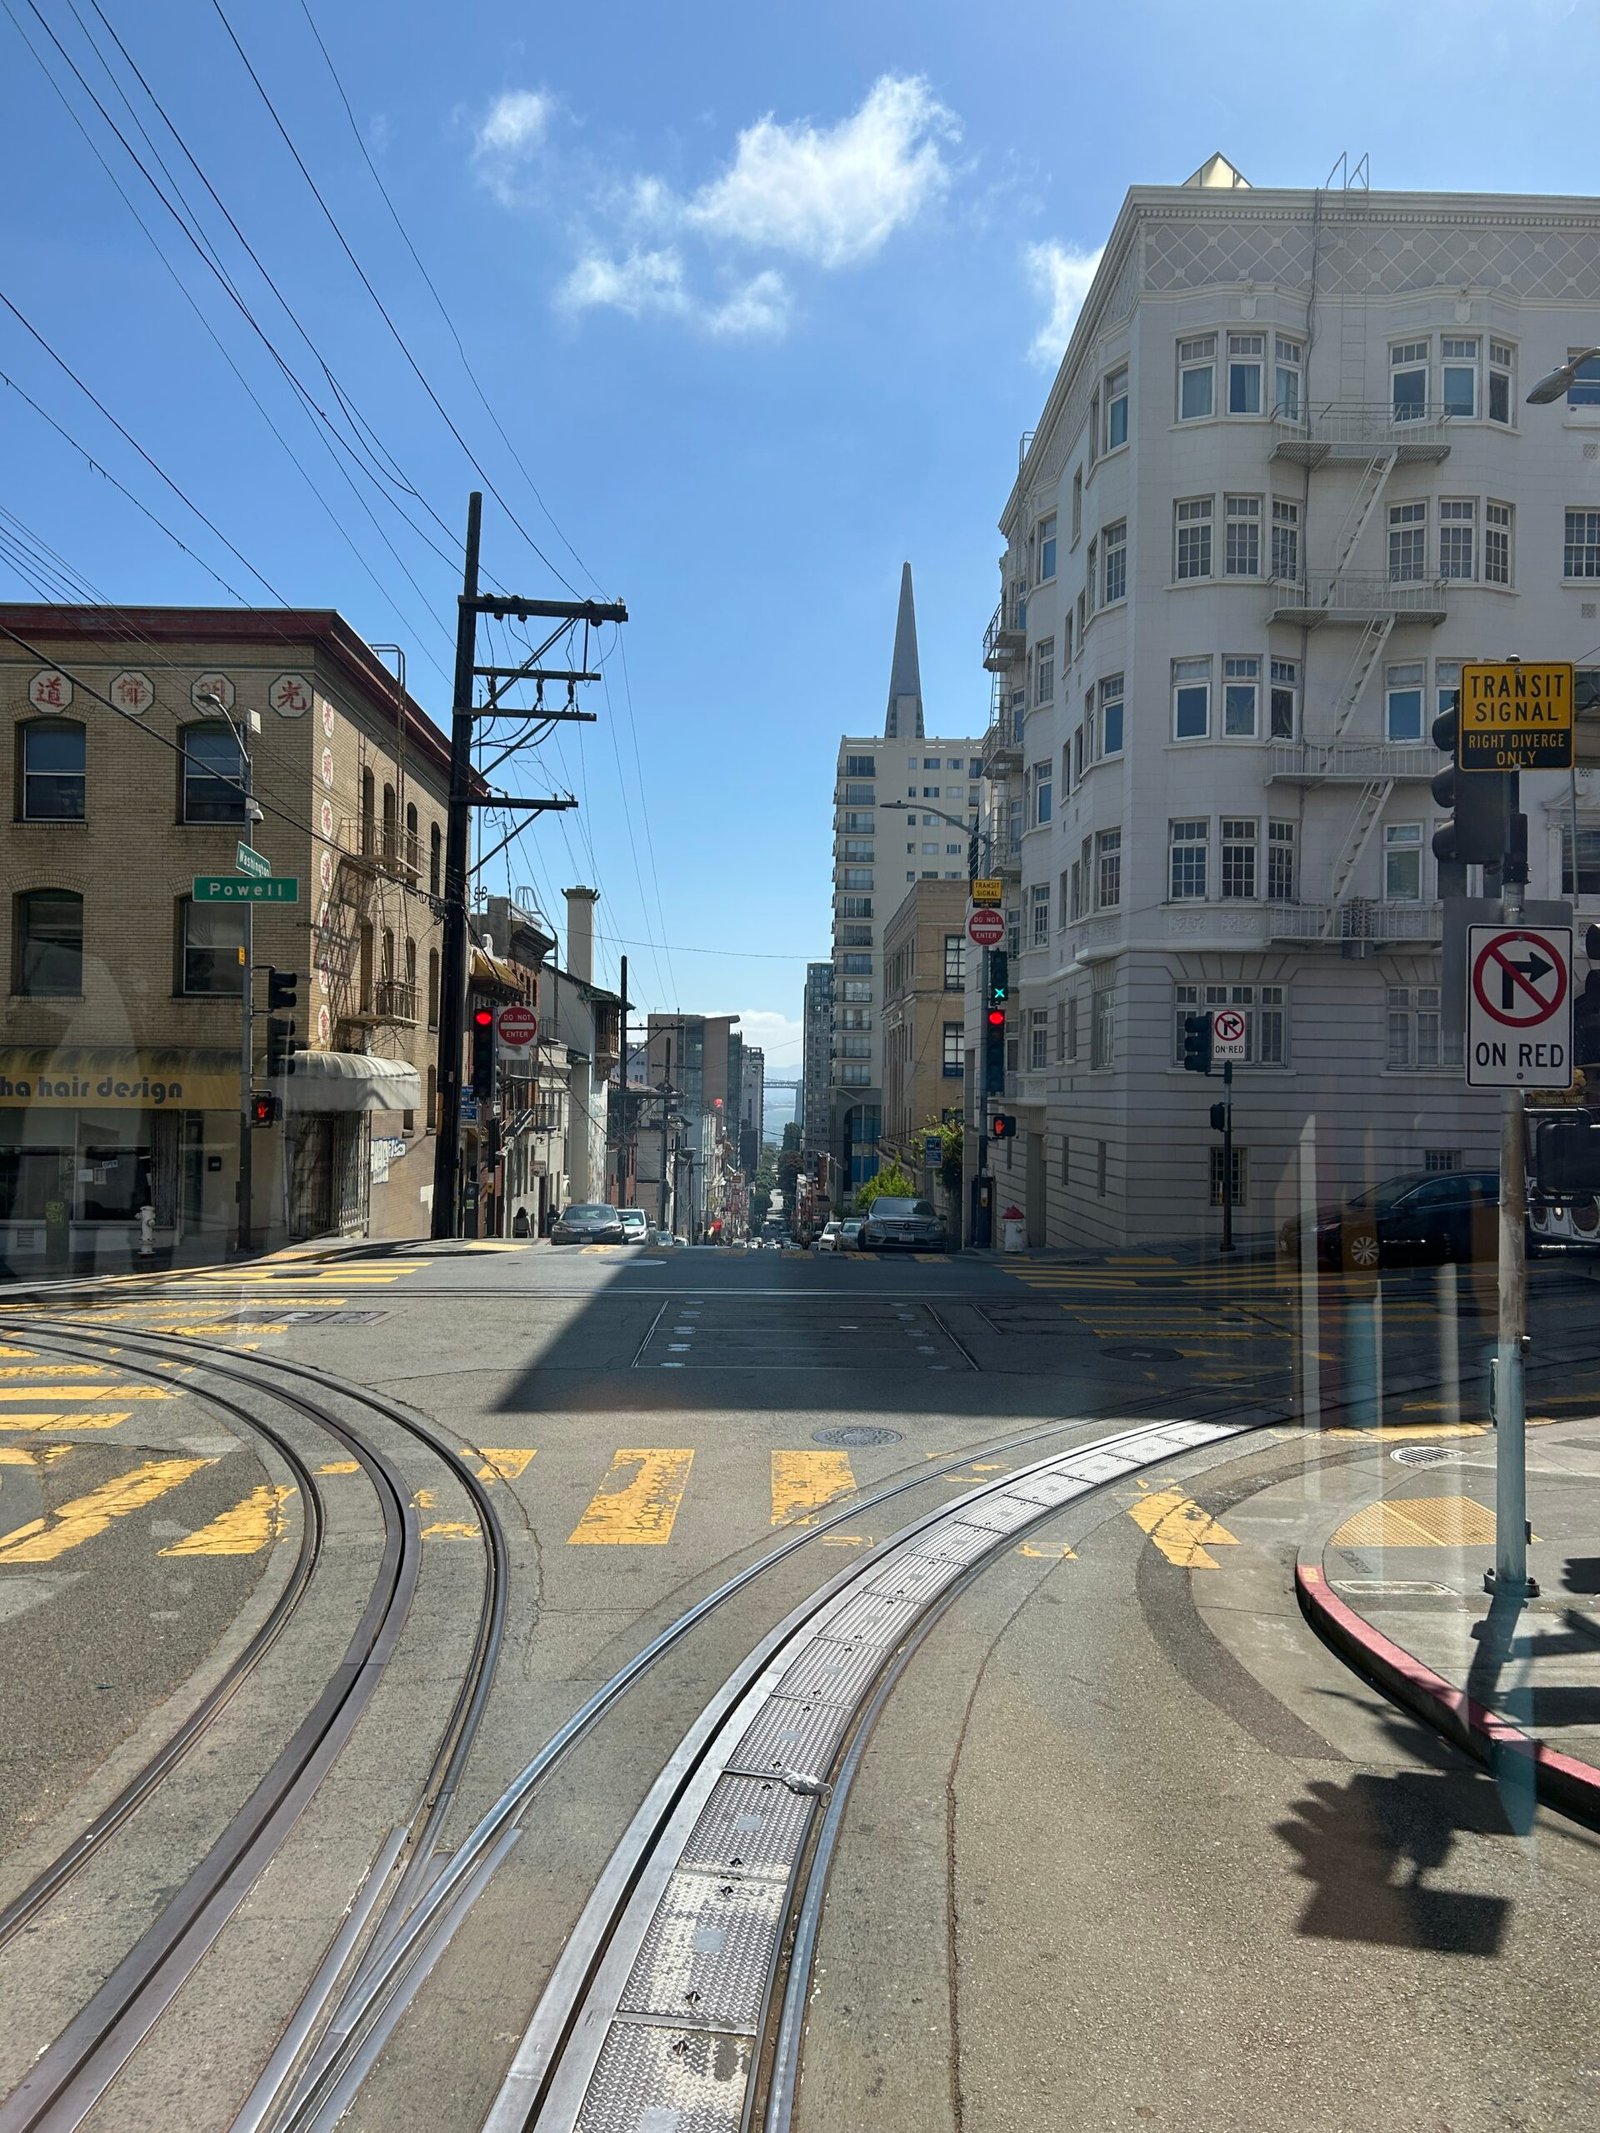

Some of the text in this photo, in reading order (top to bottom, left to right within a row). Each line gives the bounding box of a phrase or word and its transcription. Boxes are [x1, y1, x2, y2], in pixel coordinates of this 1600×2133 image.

[1470, 674, 1564, 698] TRANSIT
[1475, 701, 1559, 722] SIGNAL
[1468, 733, 1565, 749] RIGHT DIVERGE
[1496, 751, 1537, 765] ONLY
[239, 849, 271, 877] Washington
[209, 882, 282, 897] Powell
[975, 881, 1000, 889] TRANSIT
[1215, 1045, 1244, 1053] ON RED
[1476, 1042, 1564, 1068] ON RED
[38, 1075, 90, 1097] hair
[96, 1076, 183, 1105] design
